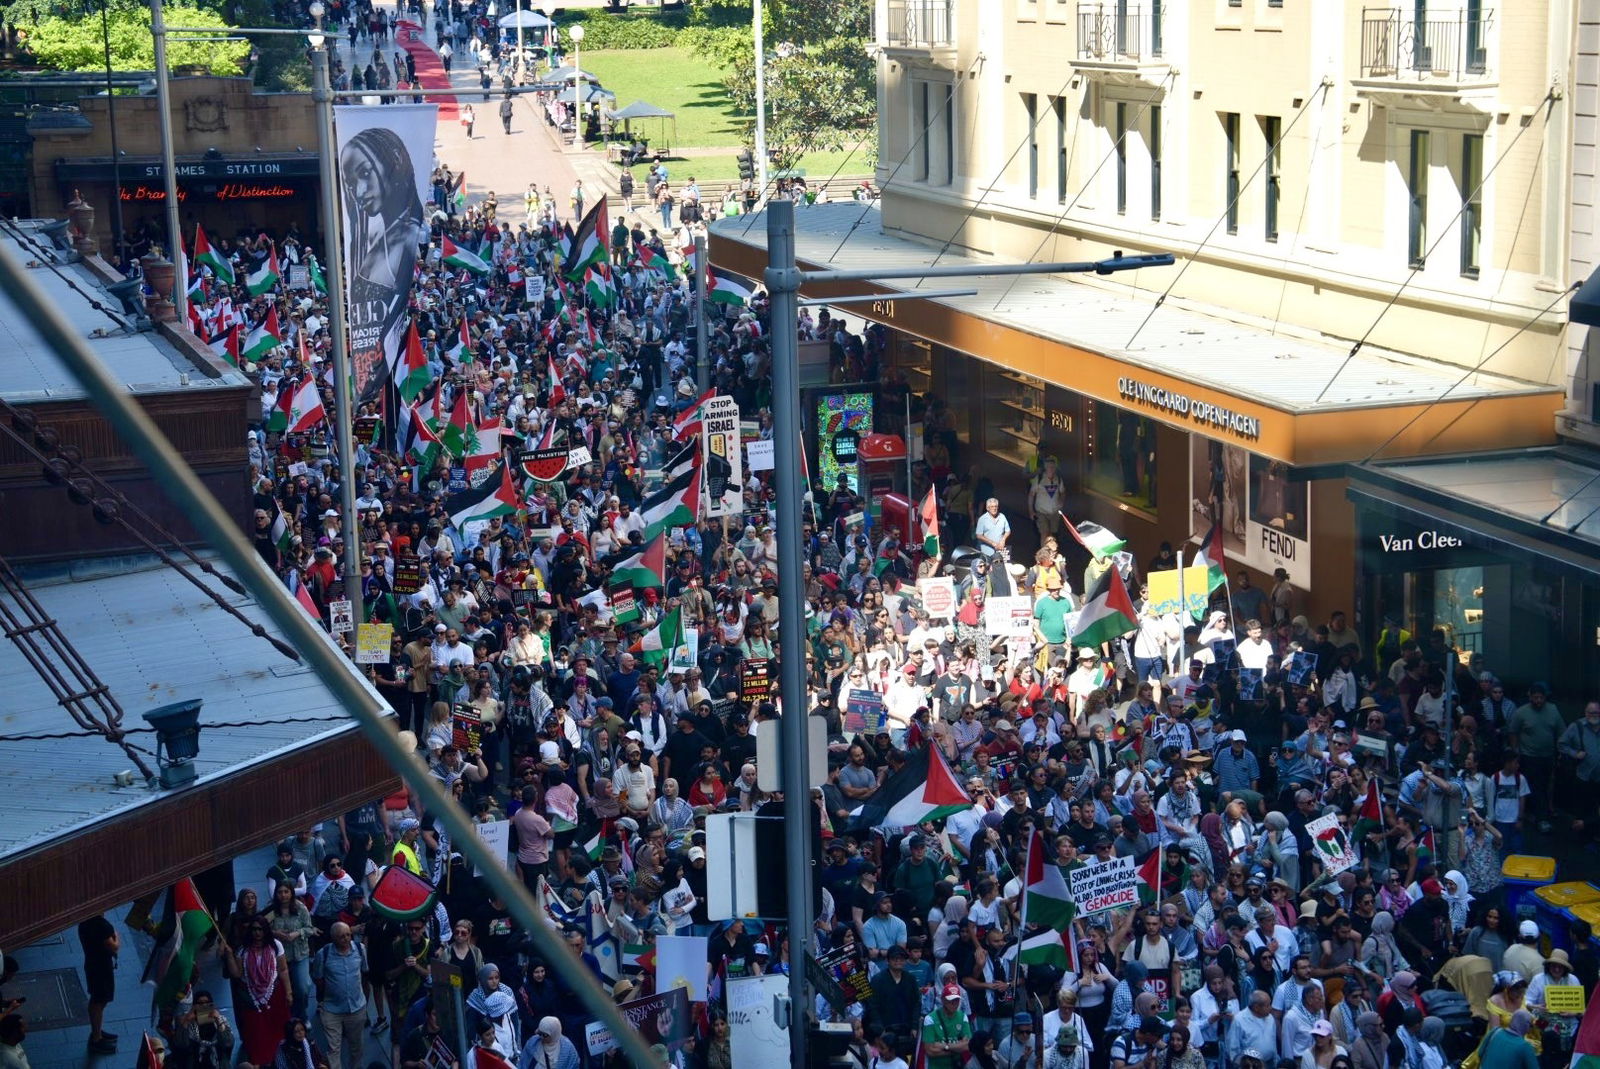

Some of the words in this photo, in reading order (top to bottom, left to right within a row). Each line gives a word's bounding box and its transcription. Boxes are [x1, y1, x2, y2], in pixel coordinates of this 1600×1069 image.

[146, 168, 161, 176] ST
[174, 166, 205, 176] AMES
[226, 164, 280, 174] STATION
[217, 184, 229, 201] of
[229, 184, 294, 198] Distinction
[710, 399, 732, 409] STOP
[1118, 377, 1134, 396] OLE
[1135, 381, 1188, 413] LYNGGAARD
[1190, 399, 1257, 436] COPENHAGEN
[704, 409, 738, 421] ARMING
[707, 418, 736, 434] ISRAEL
[520, 454, 536, 462] FREE
[537, 451, 568, 460] PALESTINE
[1262, 527, 1296, 562] FENDI
[1379, 535, 1413, 552] Van
[1417, 531, 1463, 550] Clee
[1110, 862, 1118, 871] IN
[1120, 860, 1126, 868] A
[1073, 884, 1087, 895] COST
[1087, 881, 1095, 890] OF
[1114, 869, 1136, 882] CRISIS
[1094, 887, 1105, 897] TOO
[1086, 890, 1134, 911] GENOCIDE
[623, 999, 668, 1016] ESISTANCE
